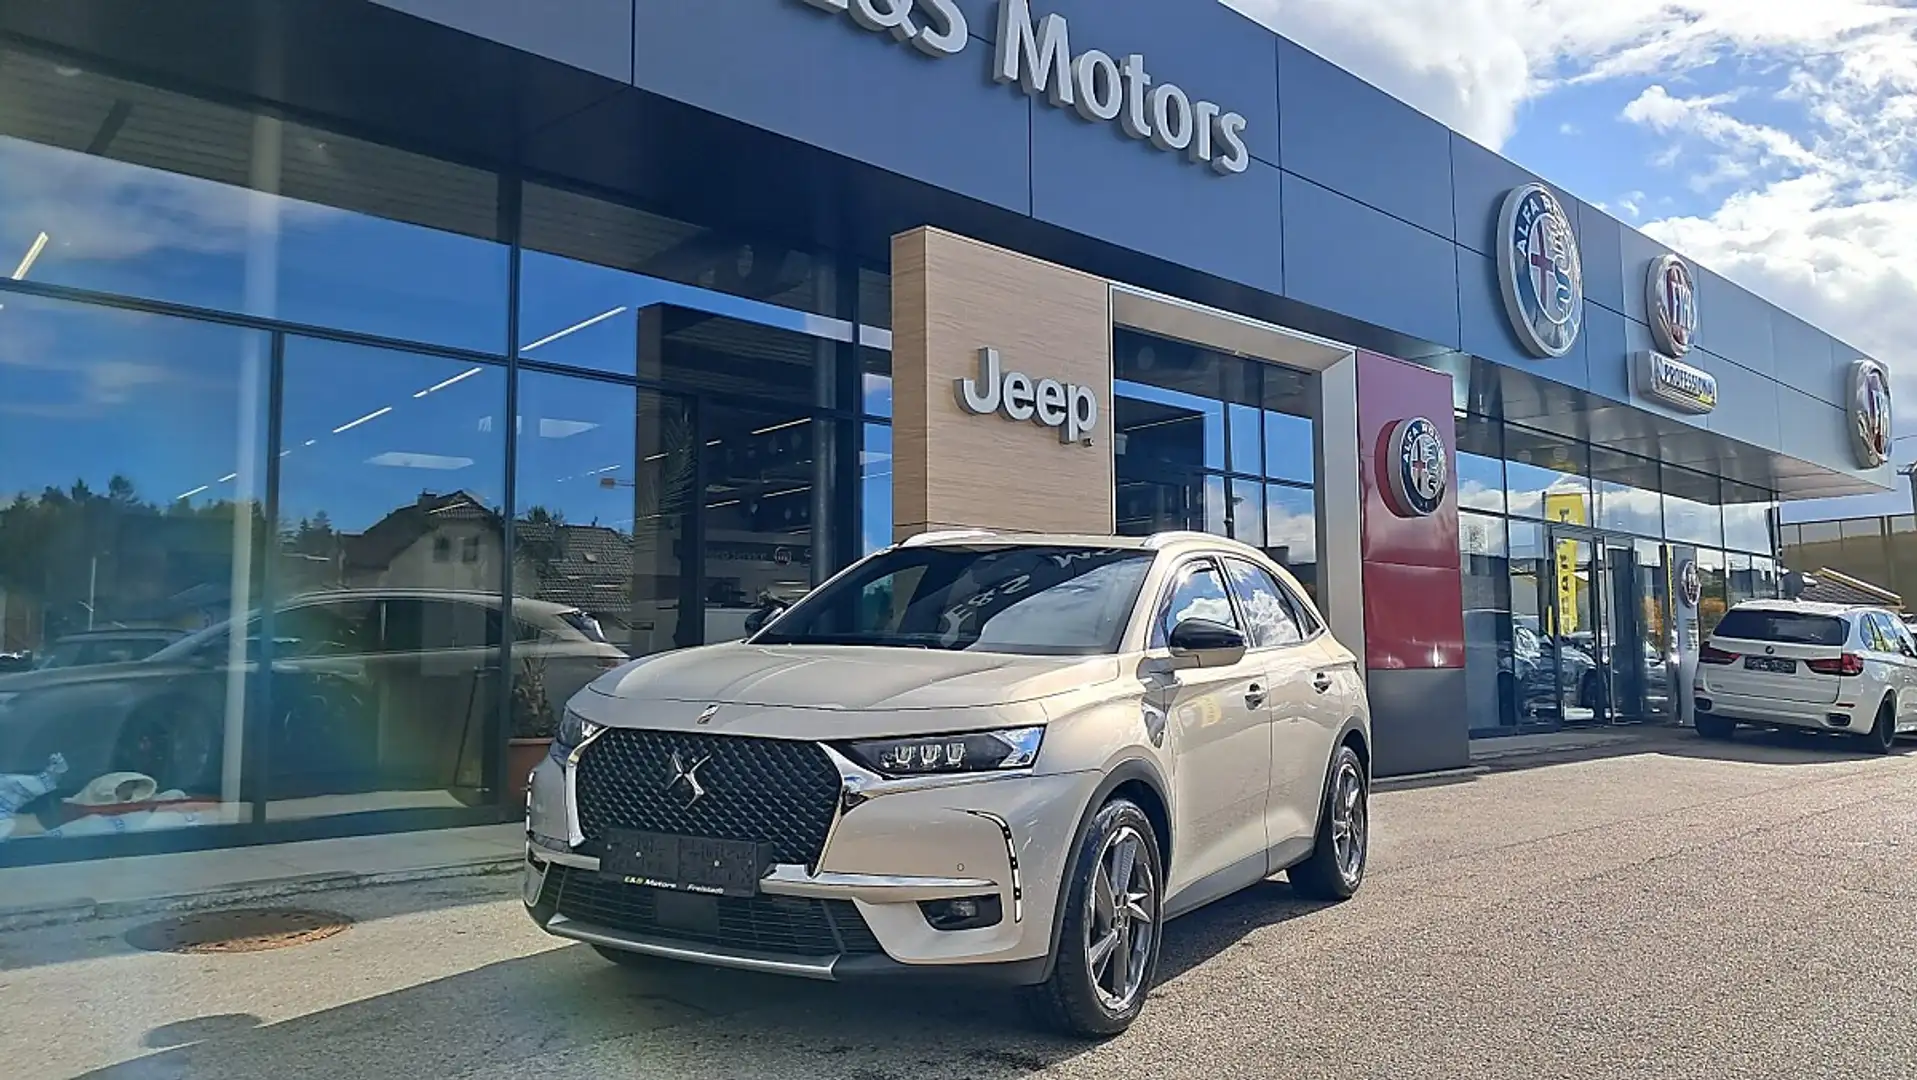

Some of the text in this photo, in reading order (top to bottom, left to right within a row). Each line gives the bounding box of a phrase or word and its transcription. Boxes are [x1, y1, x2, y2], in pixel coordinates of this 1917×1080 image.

[995, 0, 1250, 174] Motors
[1515, 198, 1541, 257] ALFA
[955, 346, 1098, 444] Jeep
[1403, 426, 1420, 463] ALFA
[644, 878, 678, 889] Motors
